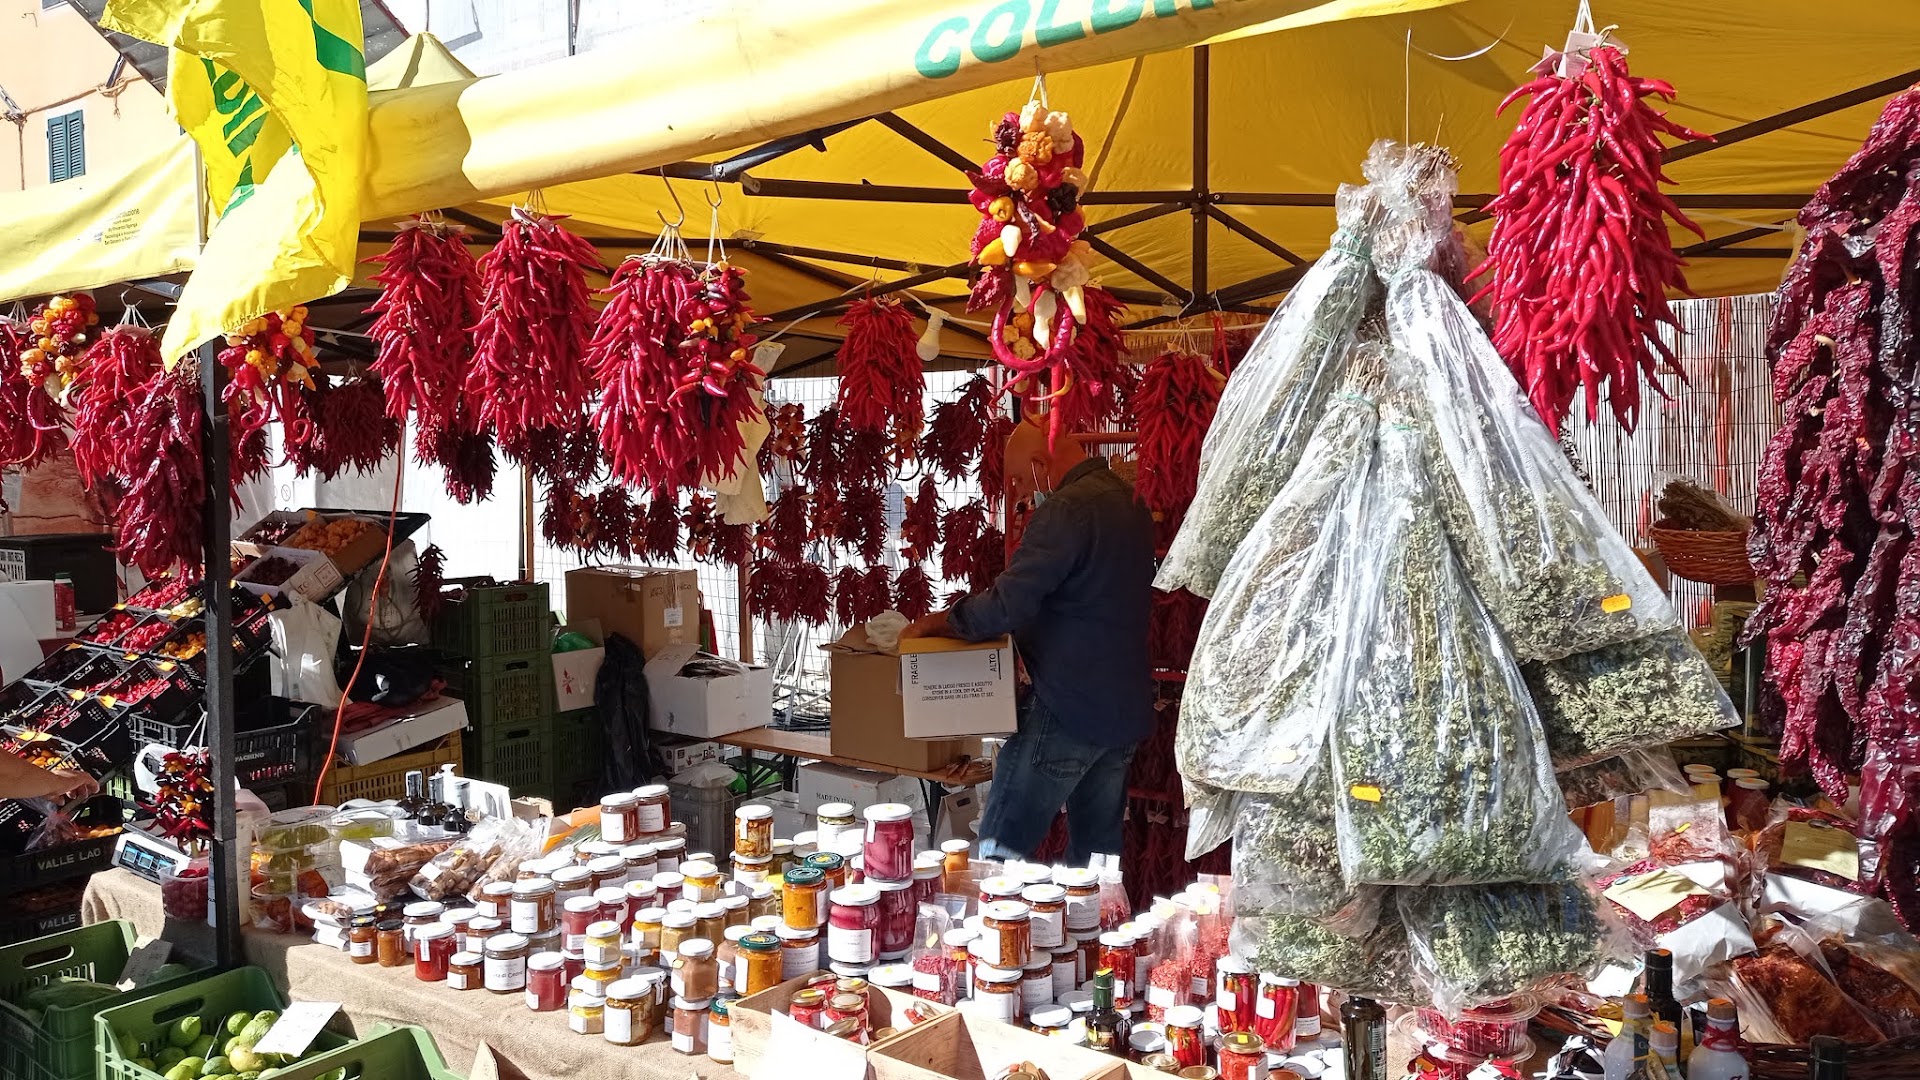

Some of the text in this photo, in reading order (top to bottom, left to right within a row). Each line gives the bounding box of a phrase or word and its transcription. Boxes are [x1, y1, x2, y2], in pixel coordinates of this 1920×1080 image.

[910, 654, 918, 684] FRAGILE
[816, 792, 831, 802] MADE
[37, 847, 101, 871] VALLE LAO
[40, 913, 76, 930] VALLE
